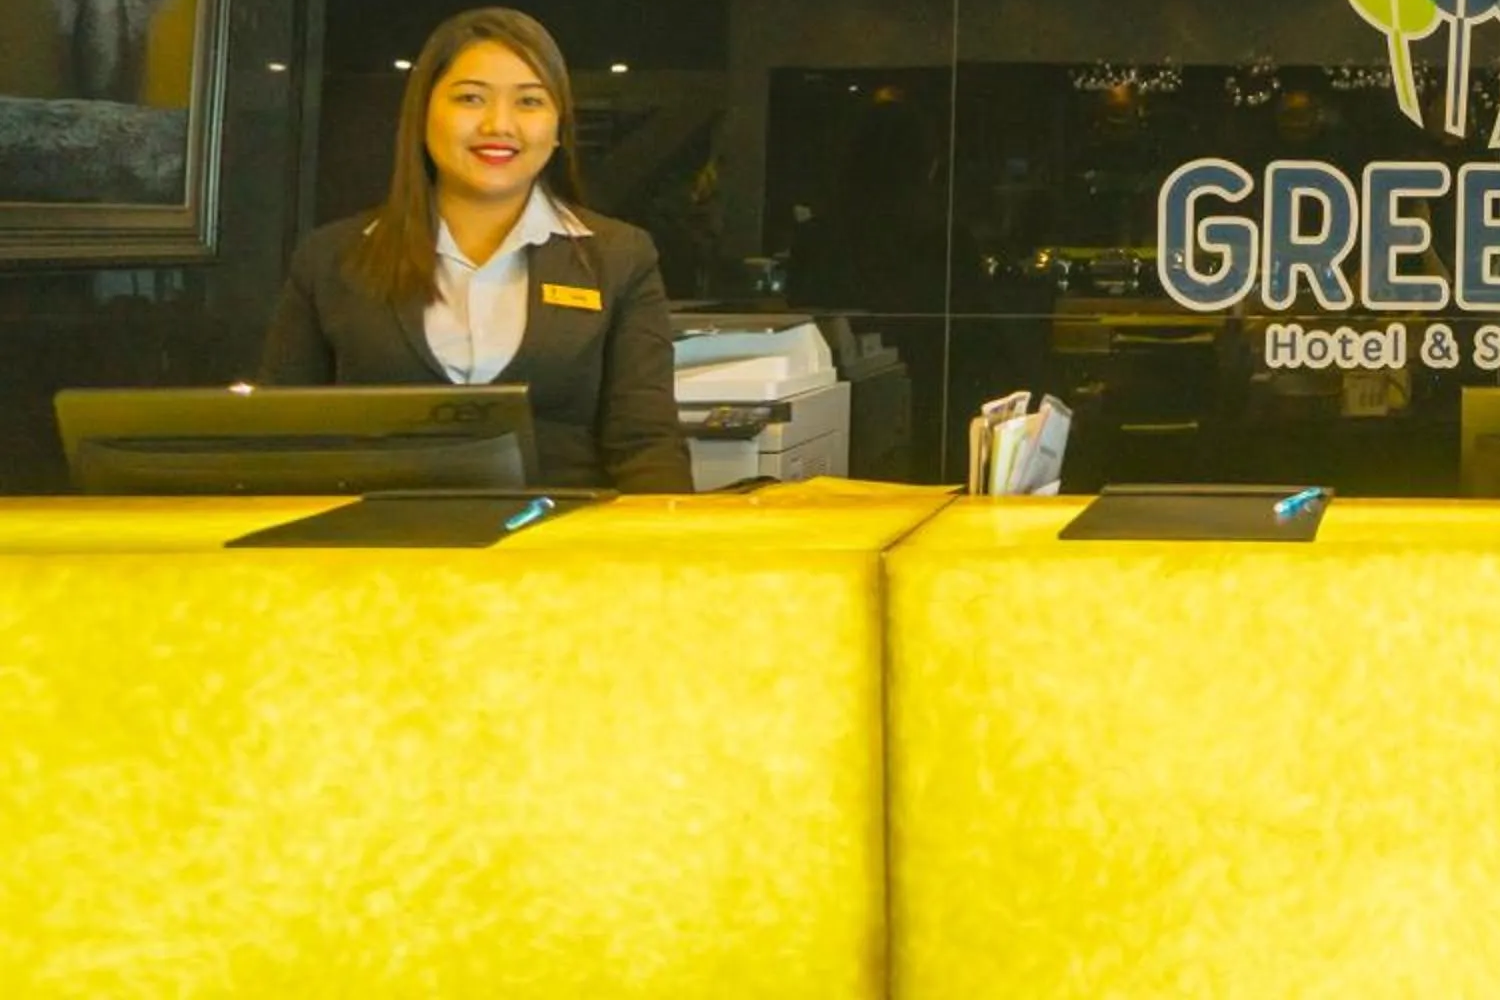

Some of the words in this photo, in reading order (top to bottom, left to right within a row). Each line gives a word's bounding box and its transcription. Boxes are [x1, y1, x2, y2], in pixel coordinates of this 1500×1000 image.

[1267, 325, 1405, 367] Hotel
[1423, 326, 1457, 366] &
[408, 400, 503, 424] cer
